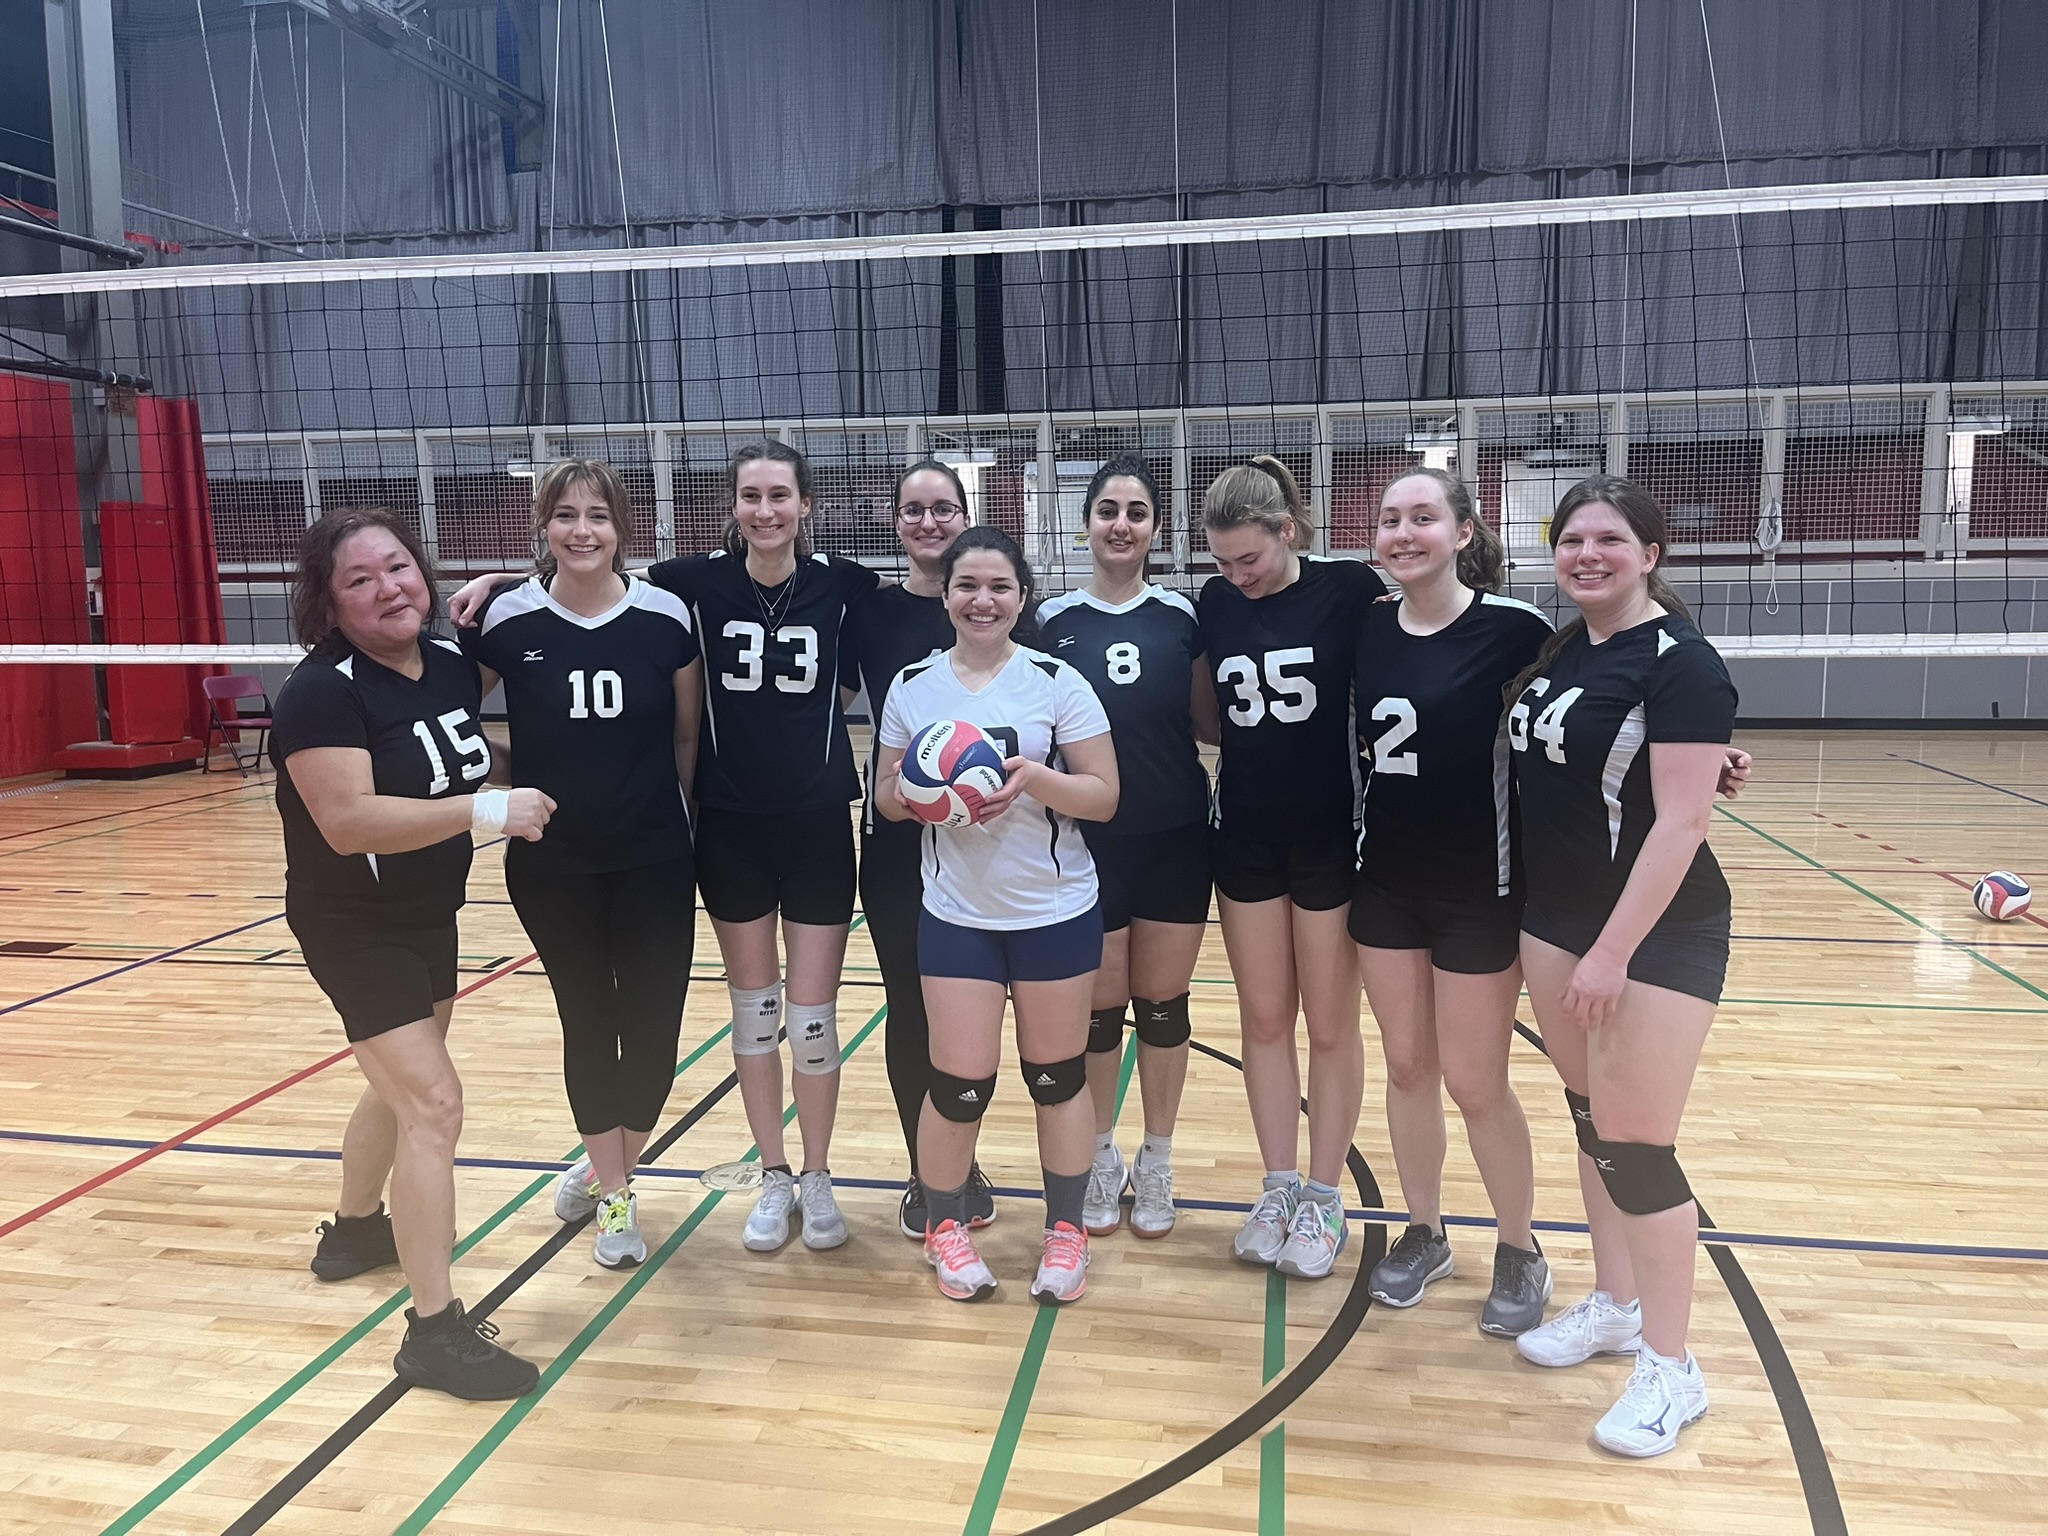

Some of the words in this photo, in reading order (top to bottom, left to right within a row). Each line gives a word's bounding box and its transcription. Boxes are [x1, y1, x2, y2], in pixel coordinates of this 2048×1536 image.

[568, 669, 624, 719] 10
[722, 620, 819, 693] 33
[1105, 641, 1141, 685] 8
[1216, 646, 1318, 727] 35
[412, 707, 491, 795] 15
[920, 724, 952, 761] molten
[1371, 696, 1418, 777] 2
[1508, 676, 1585, 764] 64
